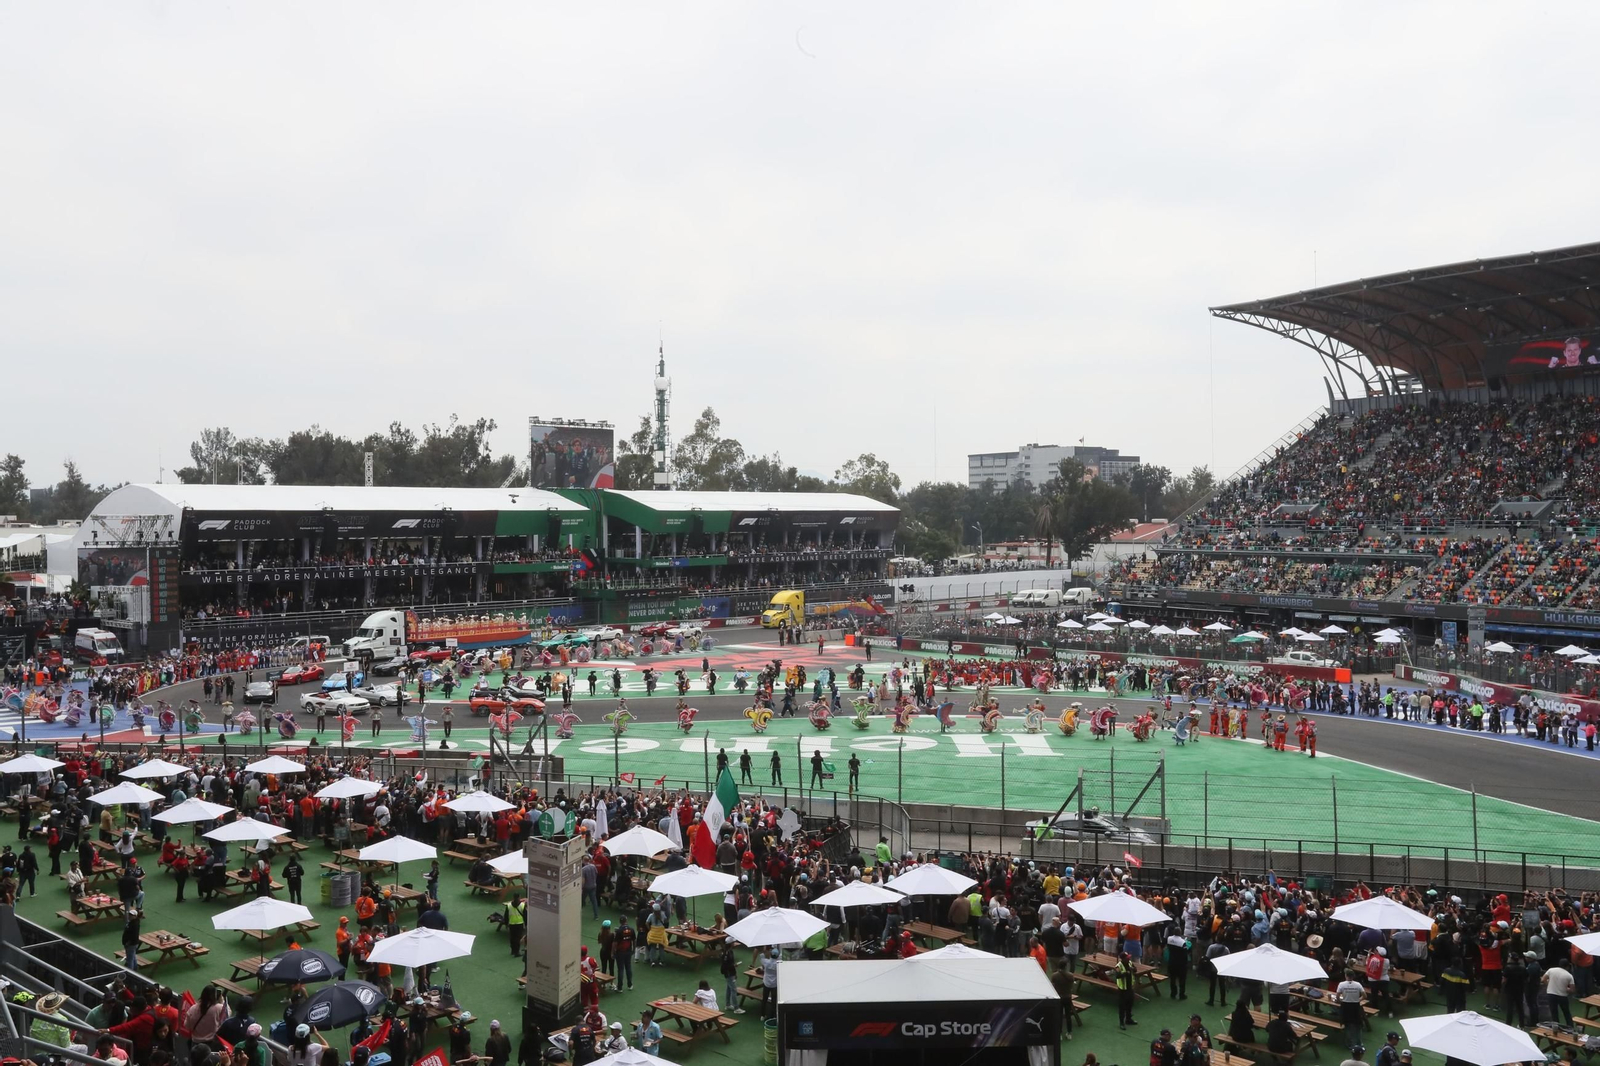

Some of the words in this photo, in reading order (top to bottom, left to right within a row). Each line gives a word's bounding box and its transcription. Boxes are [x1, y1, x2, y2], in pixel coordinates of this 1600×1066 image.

[202, 575, 253, 583] WHERE
[263, 570, 354, 581] ADRENALINE
[363, 569, 406, 577] MEETS
[414, 567, 477, 576] ELEGANCE
[647, 601, 659, 609] YOU
[242, 632, 285, 641] FORMULA
[921, 642, 963, 652] #MexicGP
[1127, 656, 1179, 668] #MexicoGP
[1206, 661, 1264, 674] #MexicoGP
[1412, 670, 1450, 685] #MexicoGP
[1459, 678, 1495, 697] #MexicoGP
[901, 1021, 936, 1038] Cap
[940, 1021, 991, 1036] Store
